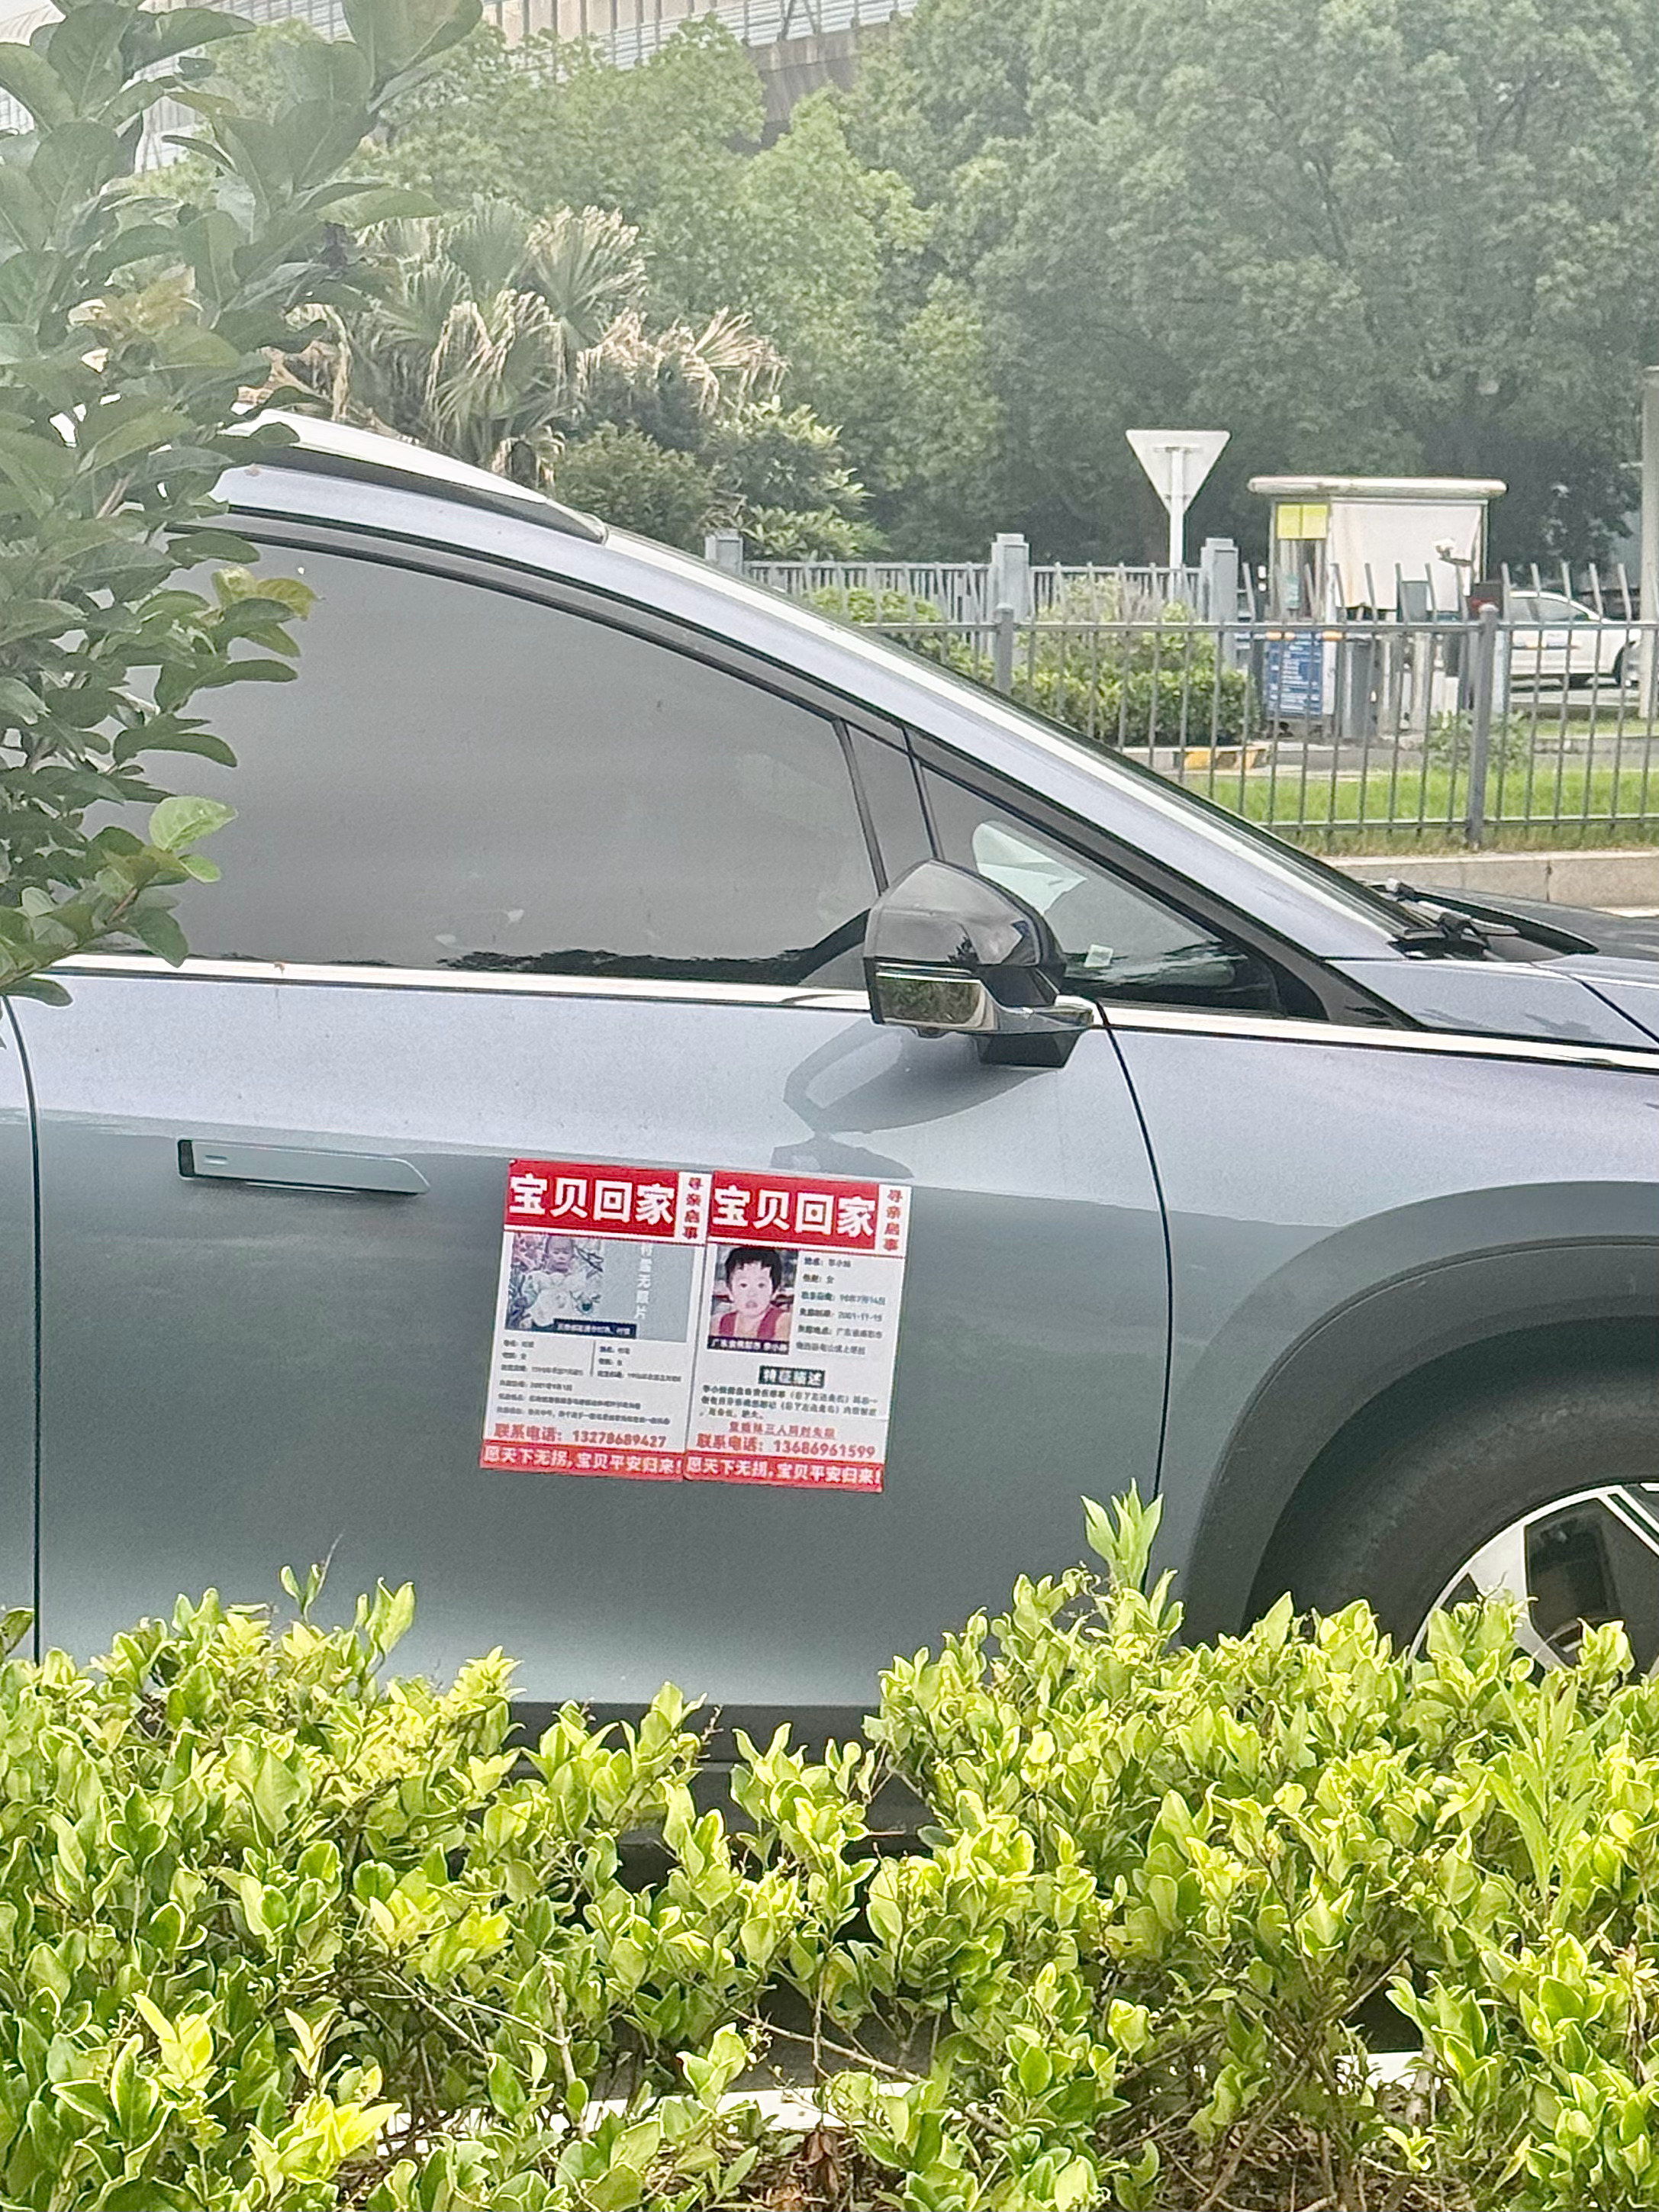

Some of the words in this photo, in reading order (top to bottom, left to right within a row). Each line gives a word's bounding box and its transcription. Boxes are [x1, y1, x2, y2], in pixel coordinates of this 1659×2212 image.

[509, 1173, 675, 1225] 宝贝回家
[681, 1177, 702, 1240] 寻亲启事
[712, 1184, 876, 1238] 宝贝回家
[883, 1189, 903, 1251] 寻亲启事
[696, 1433, 876, 1459] 联系电话：13686961599
